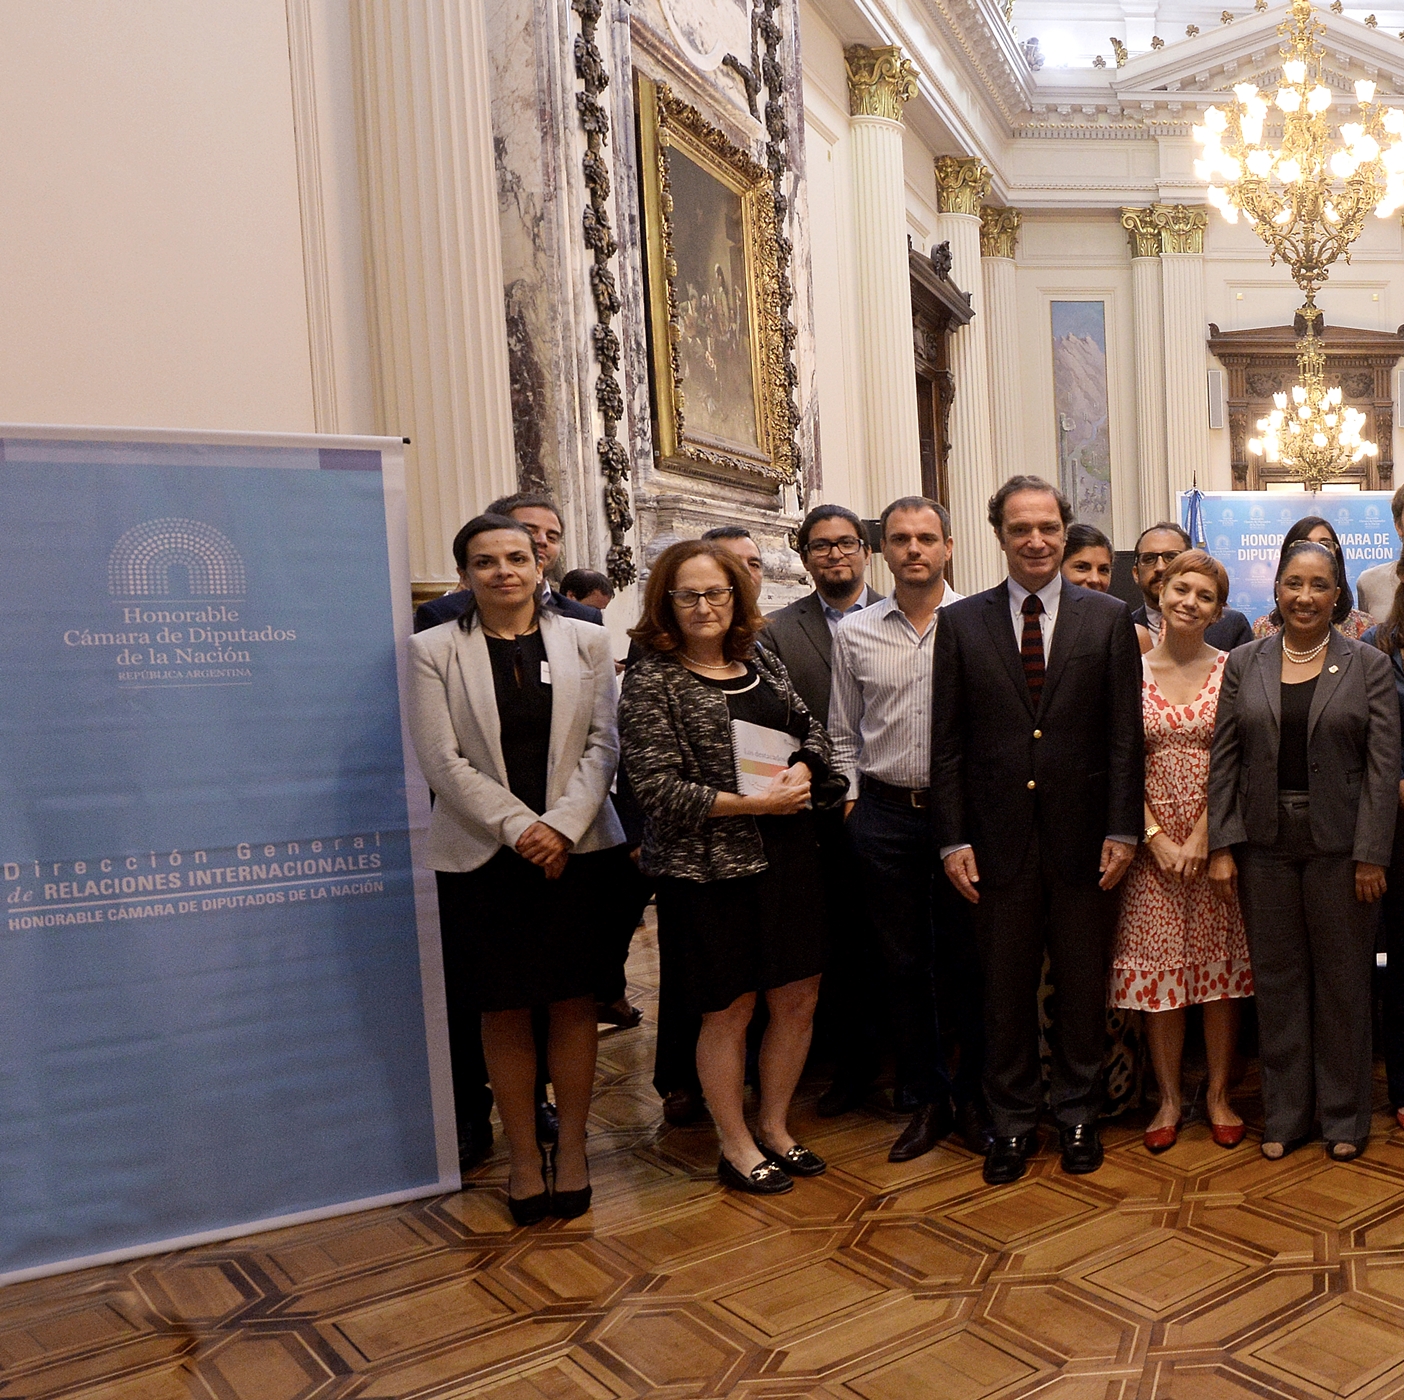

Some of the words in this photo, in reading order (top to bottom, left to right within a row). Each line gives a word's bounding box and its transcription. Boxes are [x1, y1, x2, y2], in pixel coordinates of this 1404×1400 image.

[1241, 534, 1285, 547] HONOR
[1335, 533, 1371, 546] MARA
[1373, 533, 1389, 545] DE
[1237, 548, 1281, 561] DIPUTA
[1346, 544, 1393, 560] NACIÓN
[122, 606, 239, 624] Honorable
[63, 629, 150, 647] Cámara
[156, 627, 183, 644] de
[189, 625, 297, 646] Diputados
[116, 650, 143, 666] de
[149, 648, 169, 665] la
[175, 646, 251, 664] Nación
[118, 669, 183, 681] REPÚBLICA
[187, 668, 252, 679] ARGENTINA
[3, 849, 207, 881] Dirección
[236, 831, 380, 861] General
[7, 886, 34, 904] de
[44, 872, 182, 900] RELACIONES
[187, 853, 382, 887] INTERNACIONALES
[8, 909, 104, 931] HONORABLE
[107, 902, 175, 921] CÁMARA
[178, 900, 198, 914] DE
[202, 891, 285, 912] DIPUTADOS
[289, 889, 307, 903] DE
[310, 886, 328, 900] LA
[331, 879, 384, 897] NACIÓN
